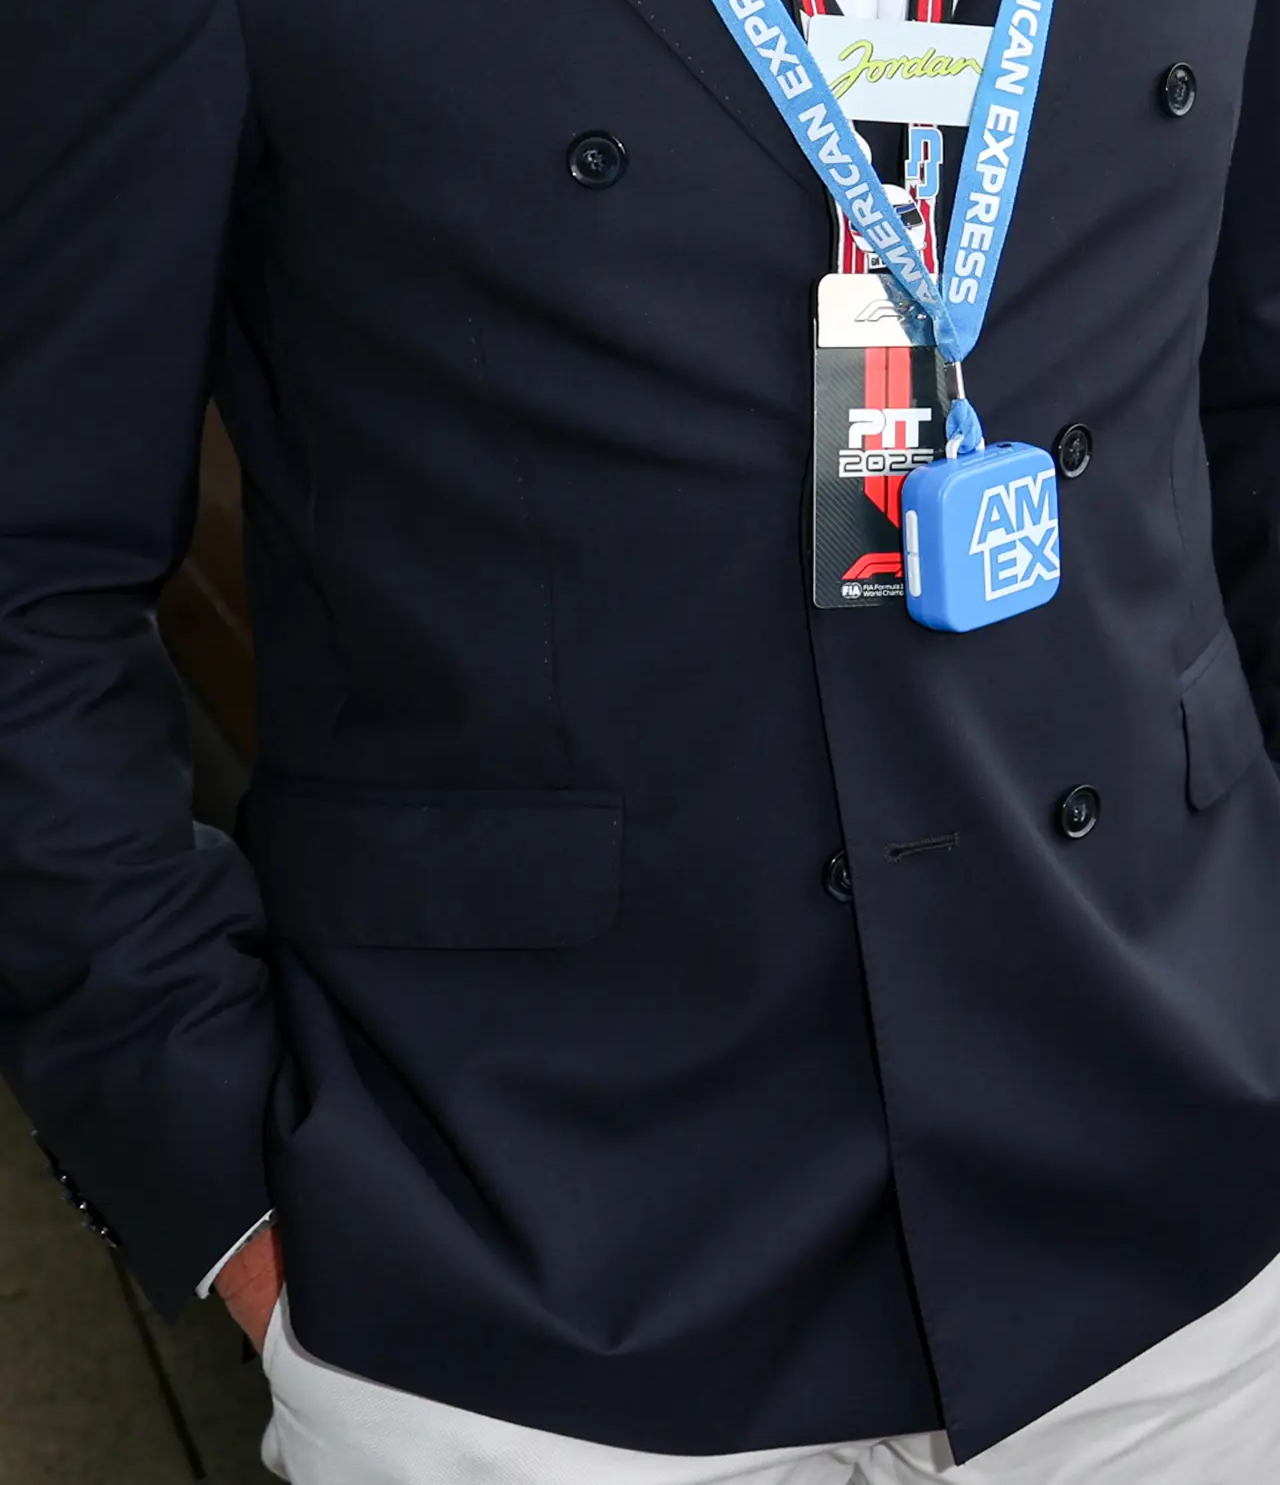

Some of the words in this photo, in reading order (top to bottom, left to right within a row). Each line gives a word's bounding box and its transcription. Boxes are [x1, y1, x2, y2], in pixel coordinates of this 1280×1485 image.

[828, 39, 984, 99] Jordan
[798, 102, 938, 308] AMERICAN
[949, 103, 1019, 304] EXPRESS
[848, 408, 932, 449] PIT
